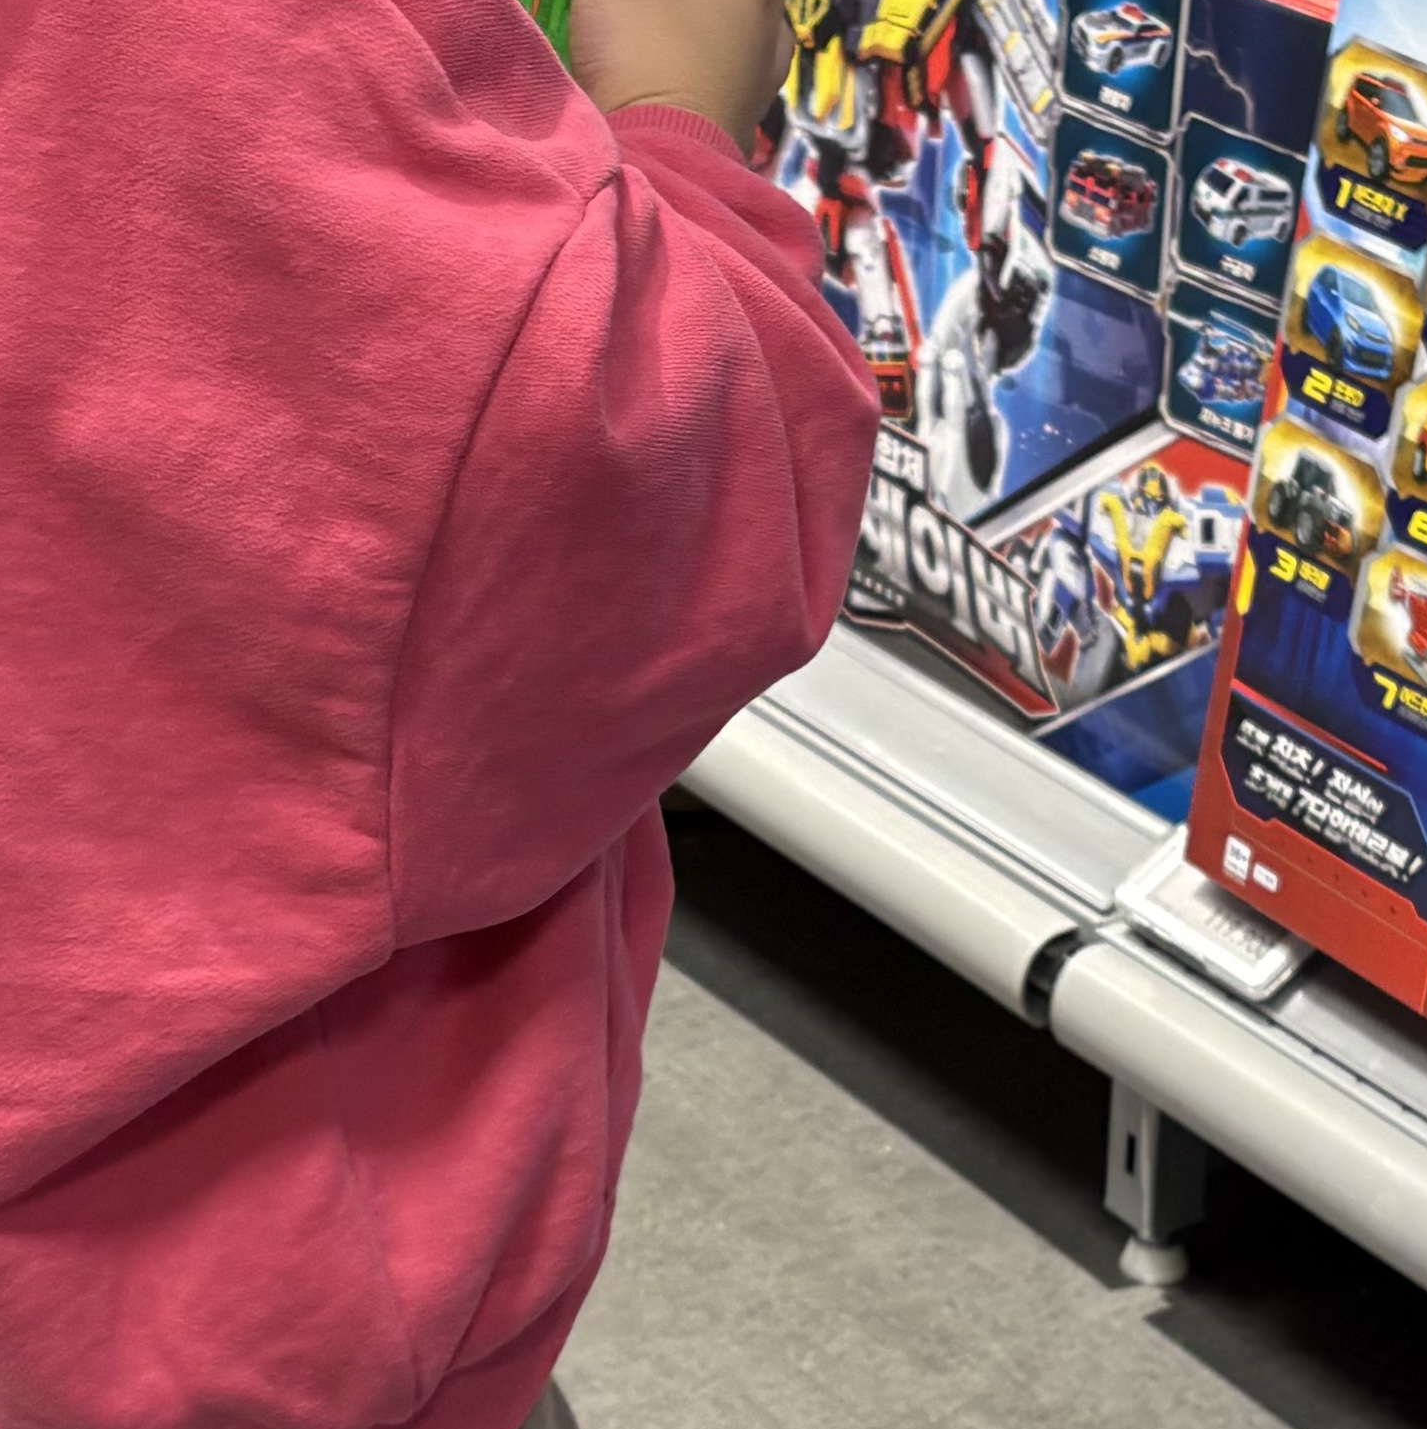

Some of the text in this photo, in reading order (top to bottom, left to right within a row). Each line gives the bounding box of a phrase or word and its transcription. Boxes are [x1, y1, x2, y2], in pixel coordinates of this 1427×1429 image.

[1335, 175, 1353, 210] 1
[1303, 366, 1332, 405] 2
[1267, 547, 1298, 584] 3
[1373, 670, 1399, 710] 7
